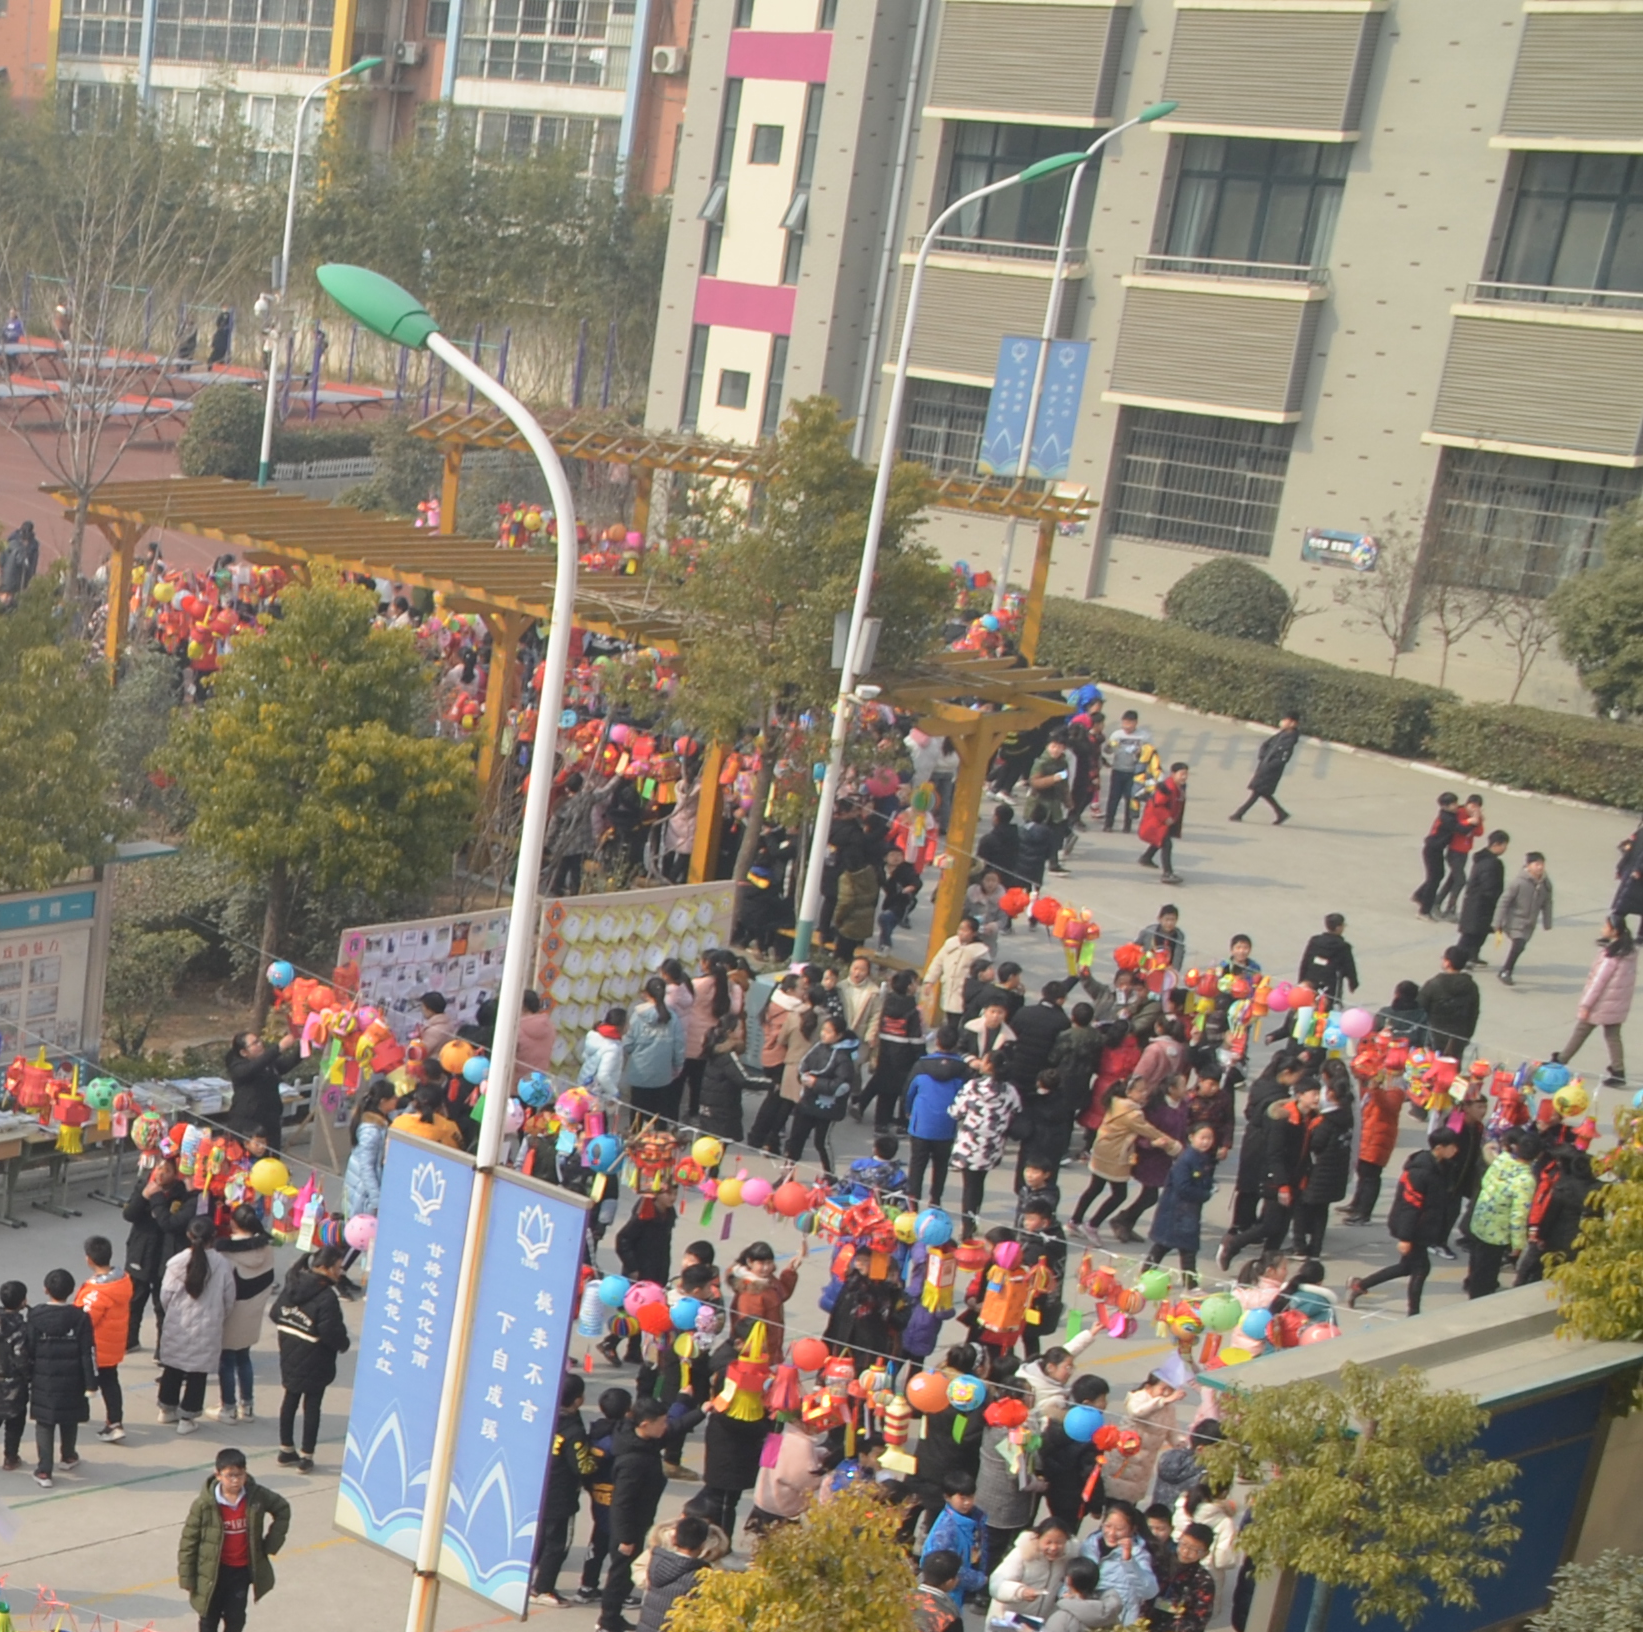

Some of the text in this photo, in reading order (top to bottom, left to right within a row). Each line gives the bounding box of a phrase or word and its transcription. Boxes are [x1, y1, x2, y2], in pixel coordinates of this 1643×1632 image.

[410, 1241, 446, 1370] 甘将心血化时雨
[518, 1288, 555, 1424] 桃李不言
[479, 1309, 517, 1444] 下自成蹊
